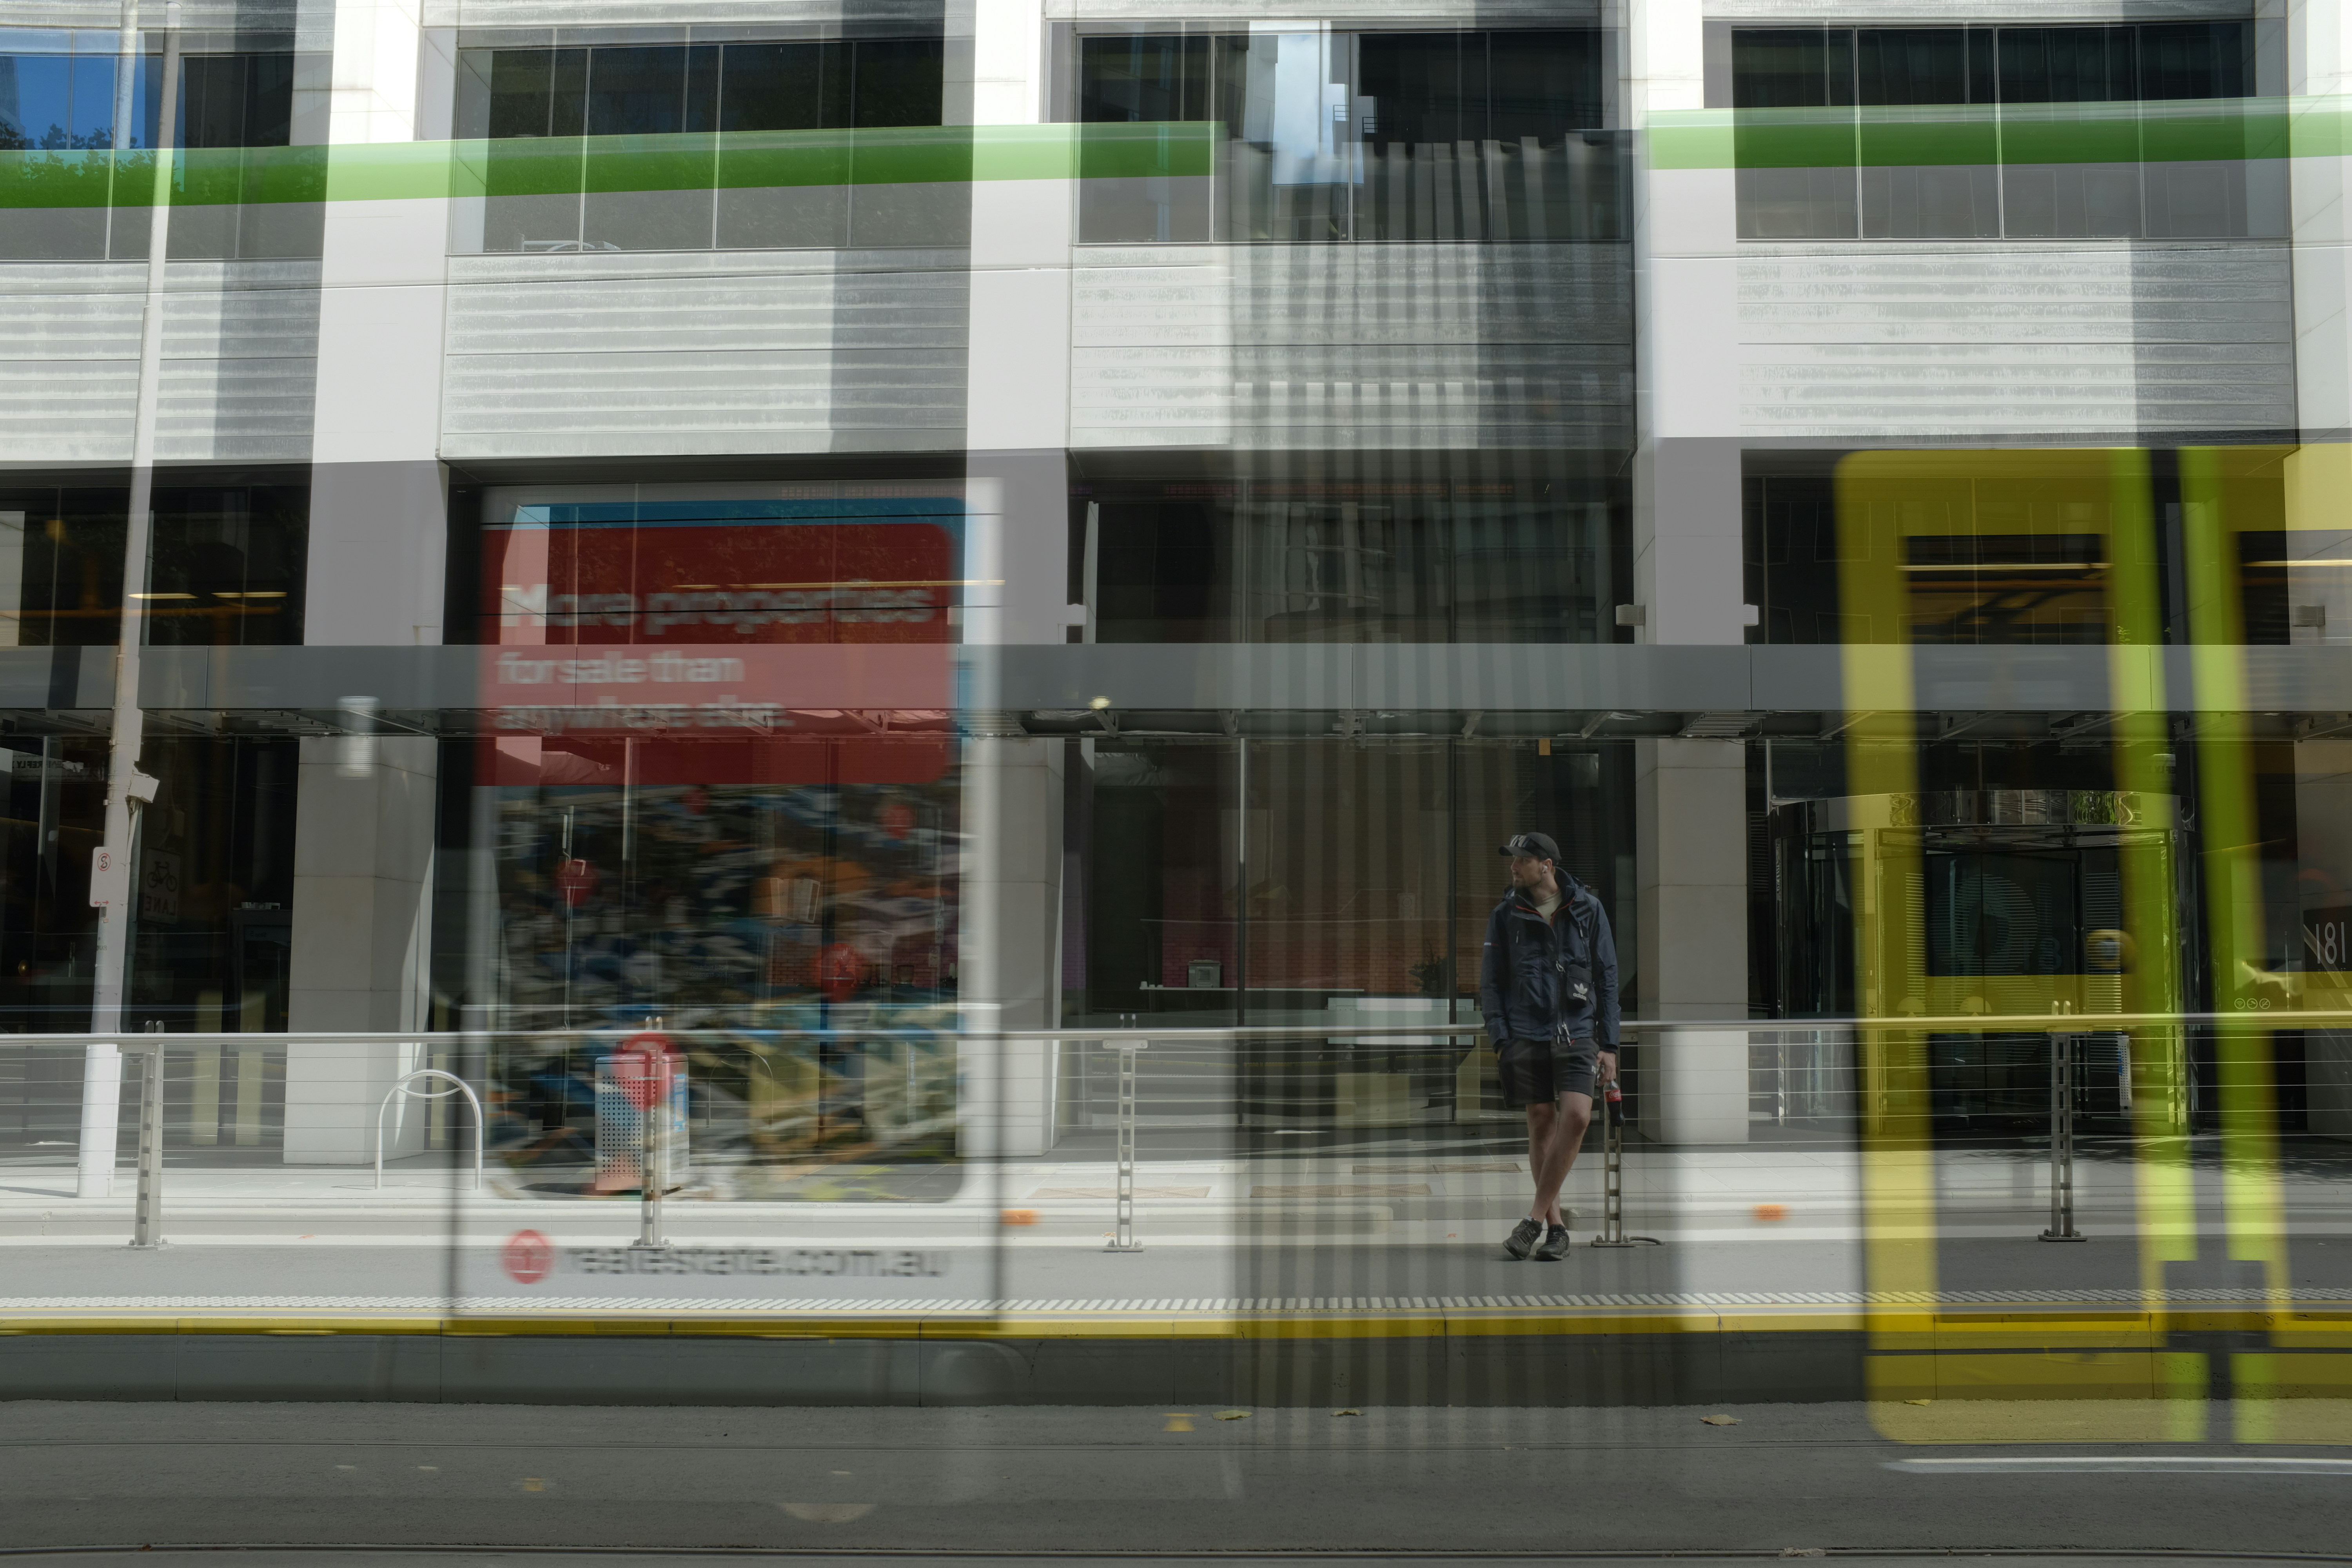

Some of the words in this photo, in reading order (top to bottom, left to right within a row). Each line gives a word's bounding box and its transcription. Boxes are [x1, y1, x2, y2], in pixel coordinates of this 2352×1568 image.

[501, 583, 641, 627] More
[643, 579, 936, 635] properties
[496, 652, 557, 684] for
[557, 651, 648, 683] sale
[649, 650, 745, 682] than
[2316, 922, 2346, 965] 181
[1573, 993, 1587, 1001] adidas
[568, 1243, 952, 1277] realestate.com.au
